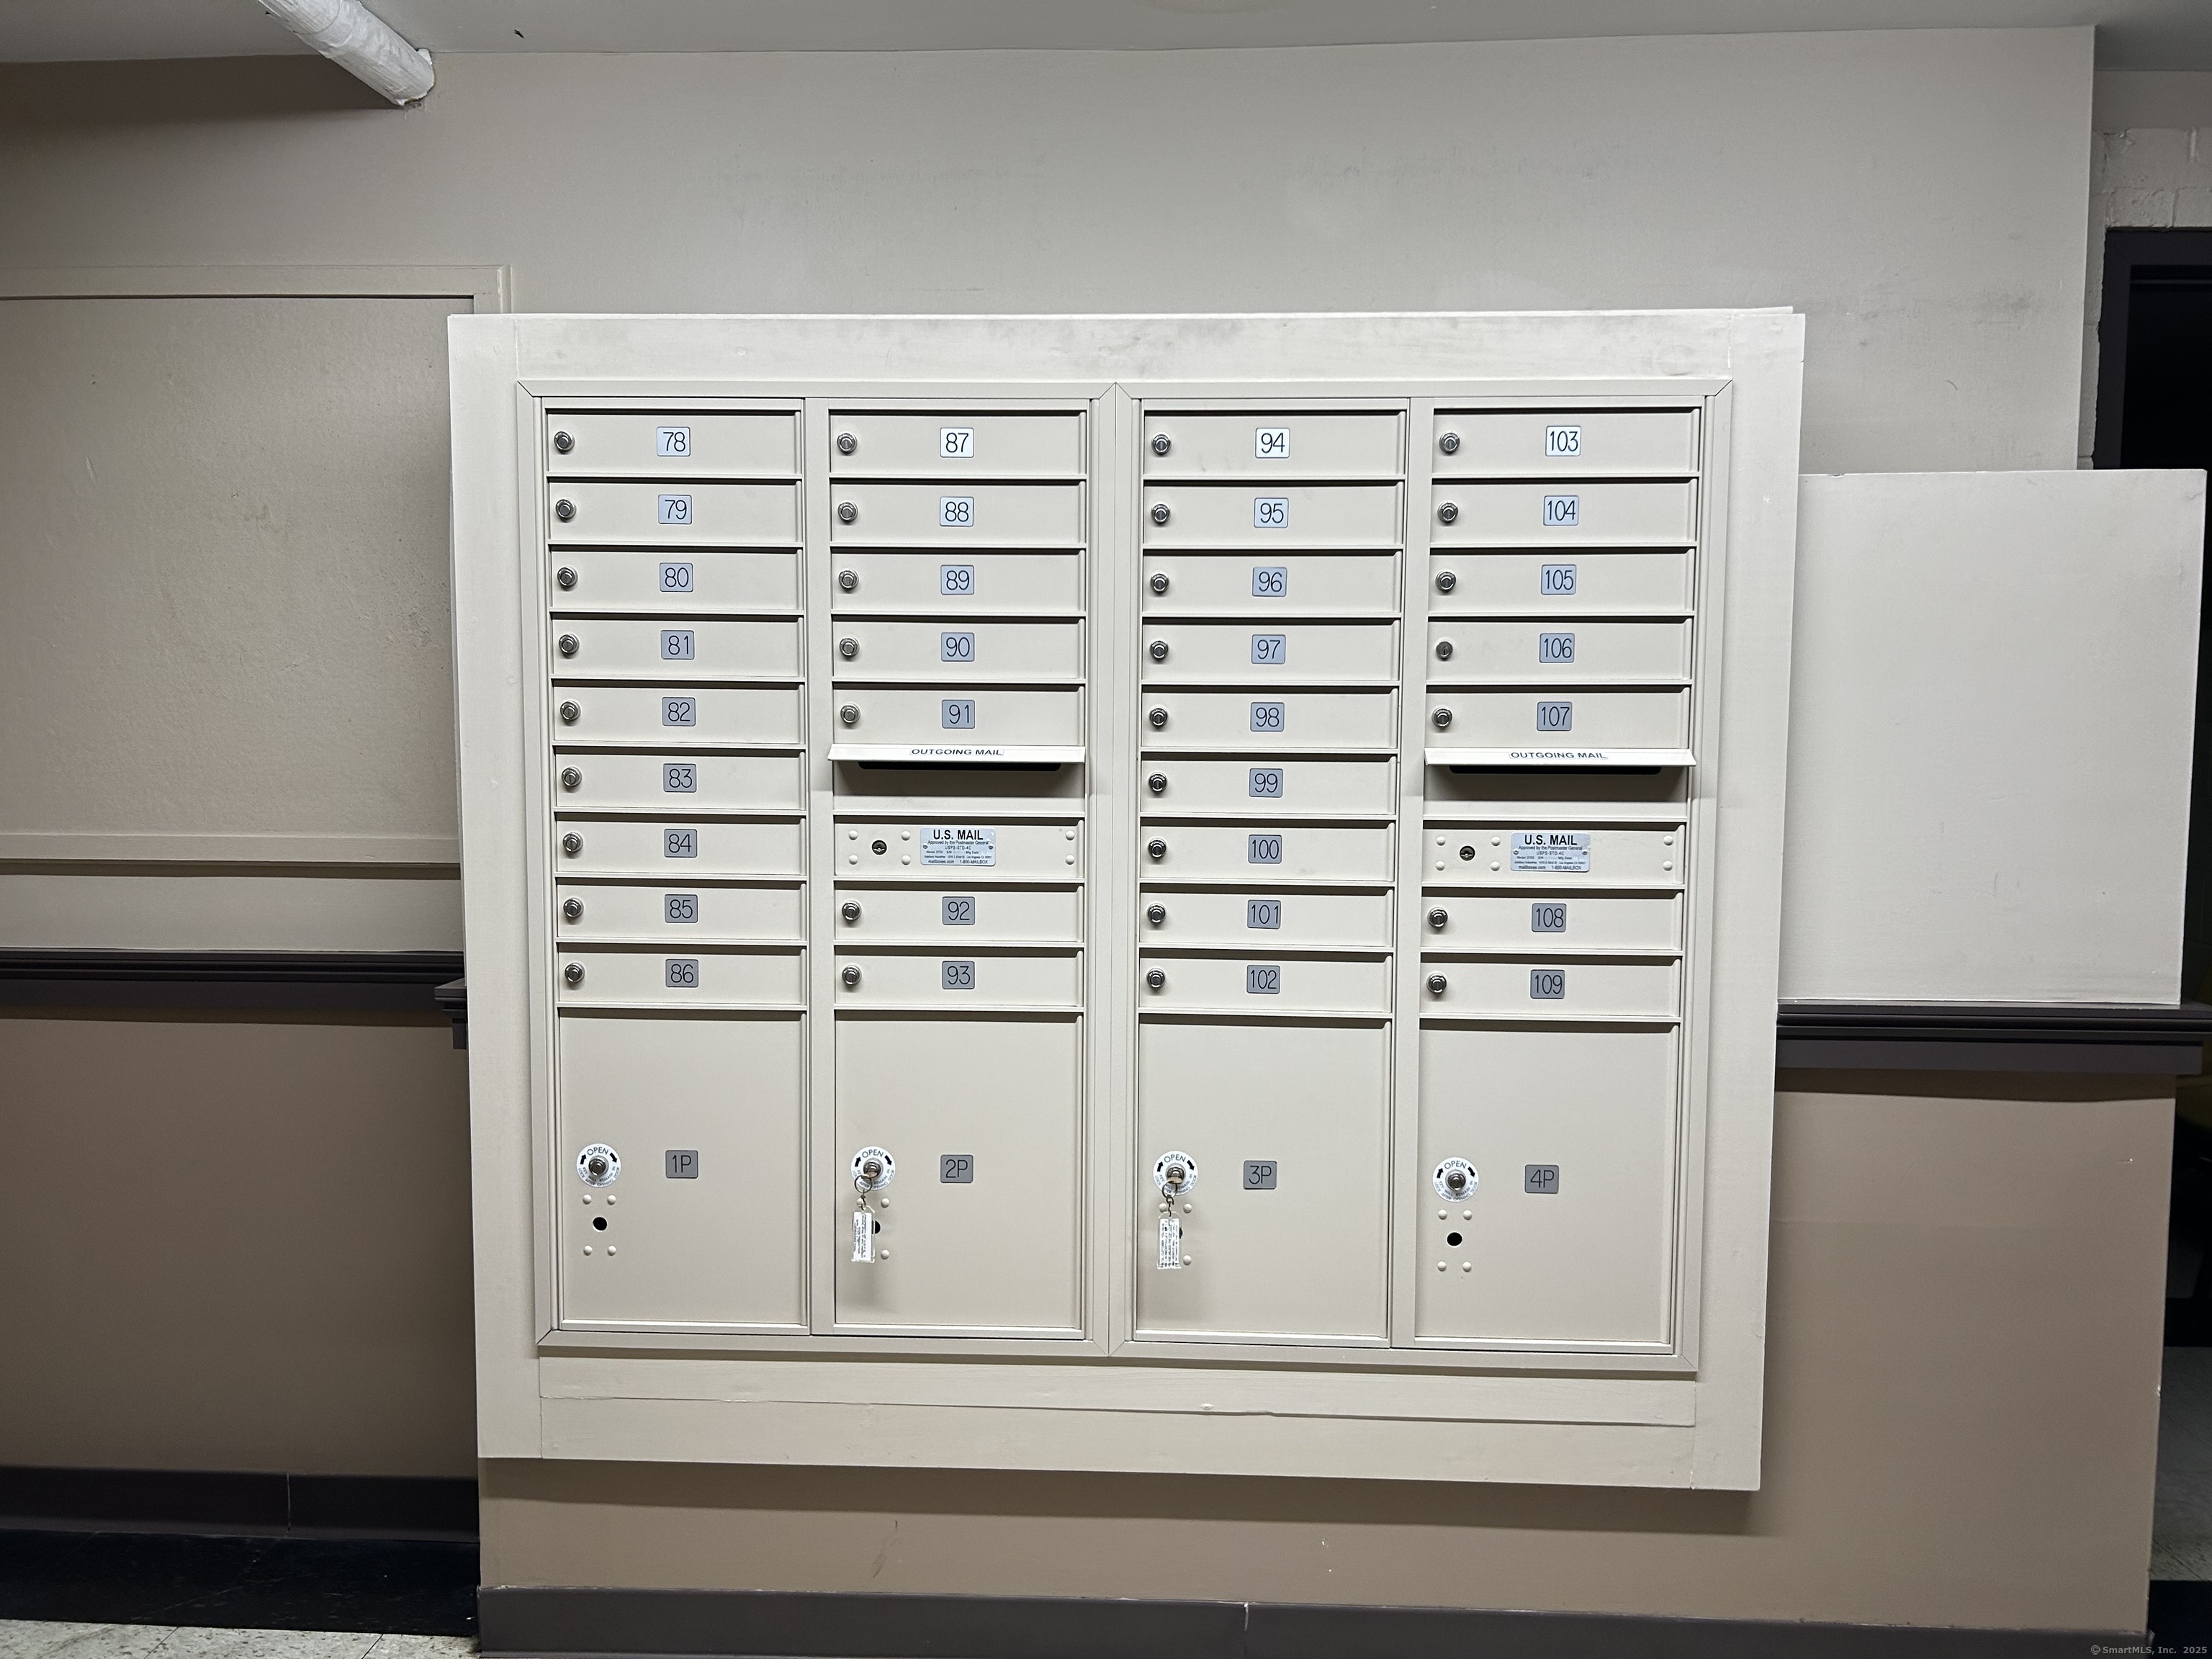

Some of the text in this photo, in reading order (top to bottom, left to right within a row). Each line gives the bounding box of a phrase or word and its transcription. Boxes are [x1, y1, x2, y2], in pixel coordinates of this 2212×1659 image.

[662, 431, 686, 452] 78
[945, 432, 969, 454] 87
[1261, 432, 1285, 454] 94
[1550, 431, 1578, 452] 103
[665, 499, 687, 520] 79
[945, 501, 969, 523] 88
[1260, 503, 1284, 524] 95
[1547, 500, 1576, 521] 104
[665, 567, 689, 588] 80
[945, 570, 970, 590] 89
[1258, 571, 1282, 593] 96
[1545, 570, 1574, 590] 105
[667, 635, 689, 655] 81
[945, 637, 971, 657] 90
[1257, 639, 1281, 660] 97
[1544, 637, 1573, 659] 106
[667, 701, 691, 722] 82
[948, 704, 969, 724] 91
[1256, 707, 1280, 727] 98
[1541, 706, 1570, 727] 107
[669, 768, 693, 788] 83
[1254, 773, 1278, 793] 99
[668, 833, 692, 853] 84
[934, 830, 983, 840] U.S. MAIL
[1524, 835, 1577, 845] U.S. MAIL
[1251, 839, 1280, 860] 100
[669, 899, 693, 919] 85
[948, 901, 970, 921] 92
[1251, 904, 1279, 925] 101
[1536, 907, 1564, 928] 108
[670, 963, 694, 984] 86
[947, 966, 971, 985] 93
[1250, 969, 1277, 989] 102
[1534, 974, 1563, 994] 109
[588, 1146, 609, 1156] OPEN
[862, 1149, 884, 1158] OPEN
[1164, 1154, 1186, 1162] OPEN
[672, 1154, 692, 1173] 1P
[945, 1159, 968, 1179] 2P
[1444, 1160, 1467, 1169] OPEN
[1249, 1165, 1272, 1185] 3P
[1530, 1169, 1555, 1188] 4P
